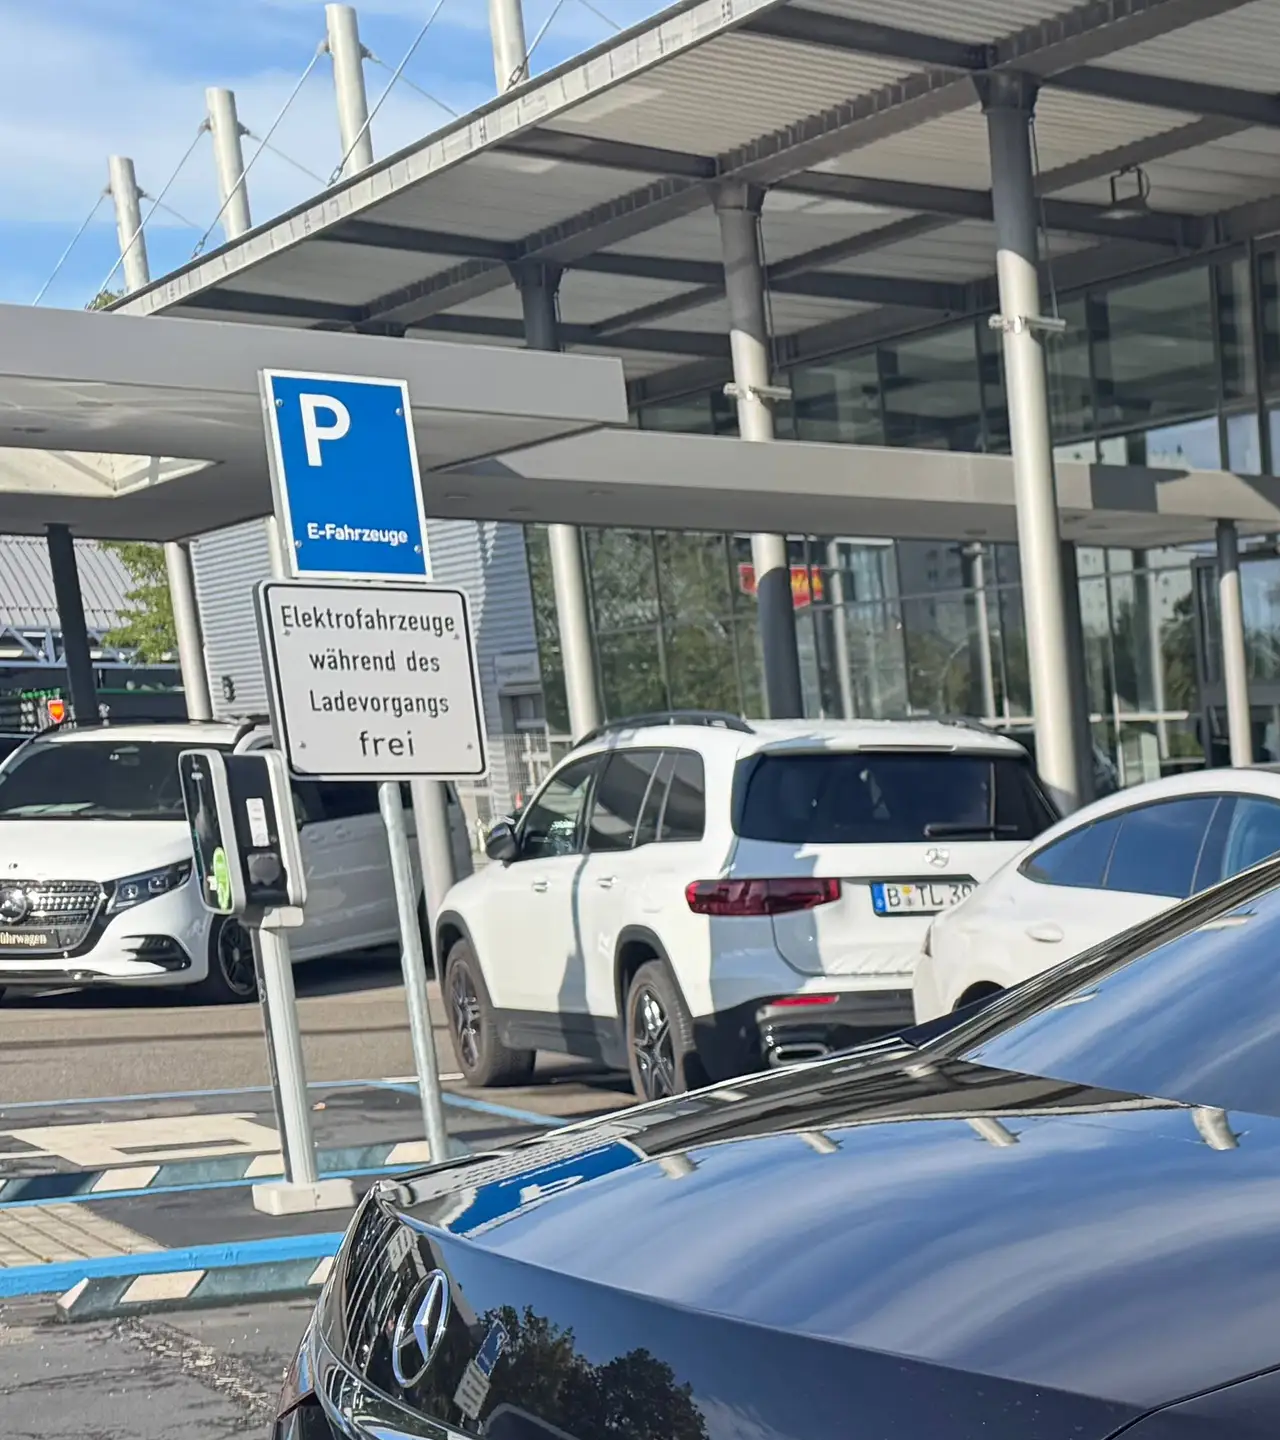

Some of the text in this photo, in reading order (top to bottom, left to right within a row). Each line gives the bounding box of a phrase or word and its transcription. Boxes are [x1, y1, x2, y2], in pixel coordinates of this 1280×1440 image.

[299, 393, 351, 467] P
[307, 522, 408, 546] E-Fahrzeuge
[281, 605, 455, 637] Elektrofahrzeuge
[309, 648, 440, 672] während des
[309, 690, 449, 717] Ladevorgangs
[359, 731, 415, 757] frei
[887, 888, 900, 907] B
[915, 884, 943, 906] TL
